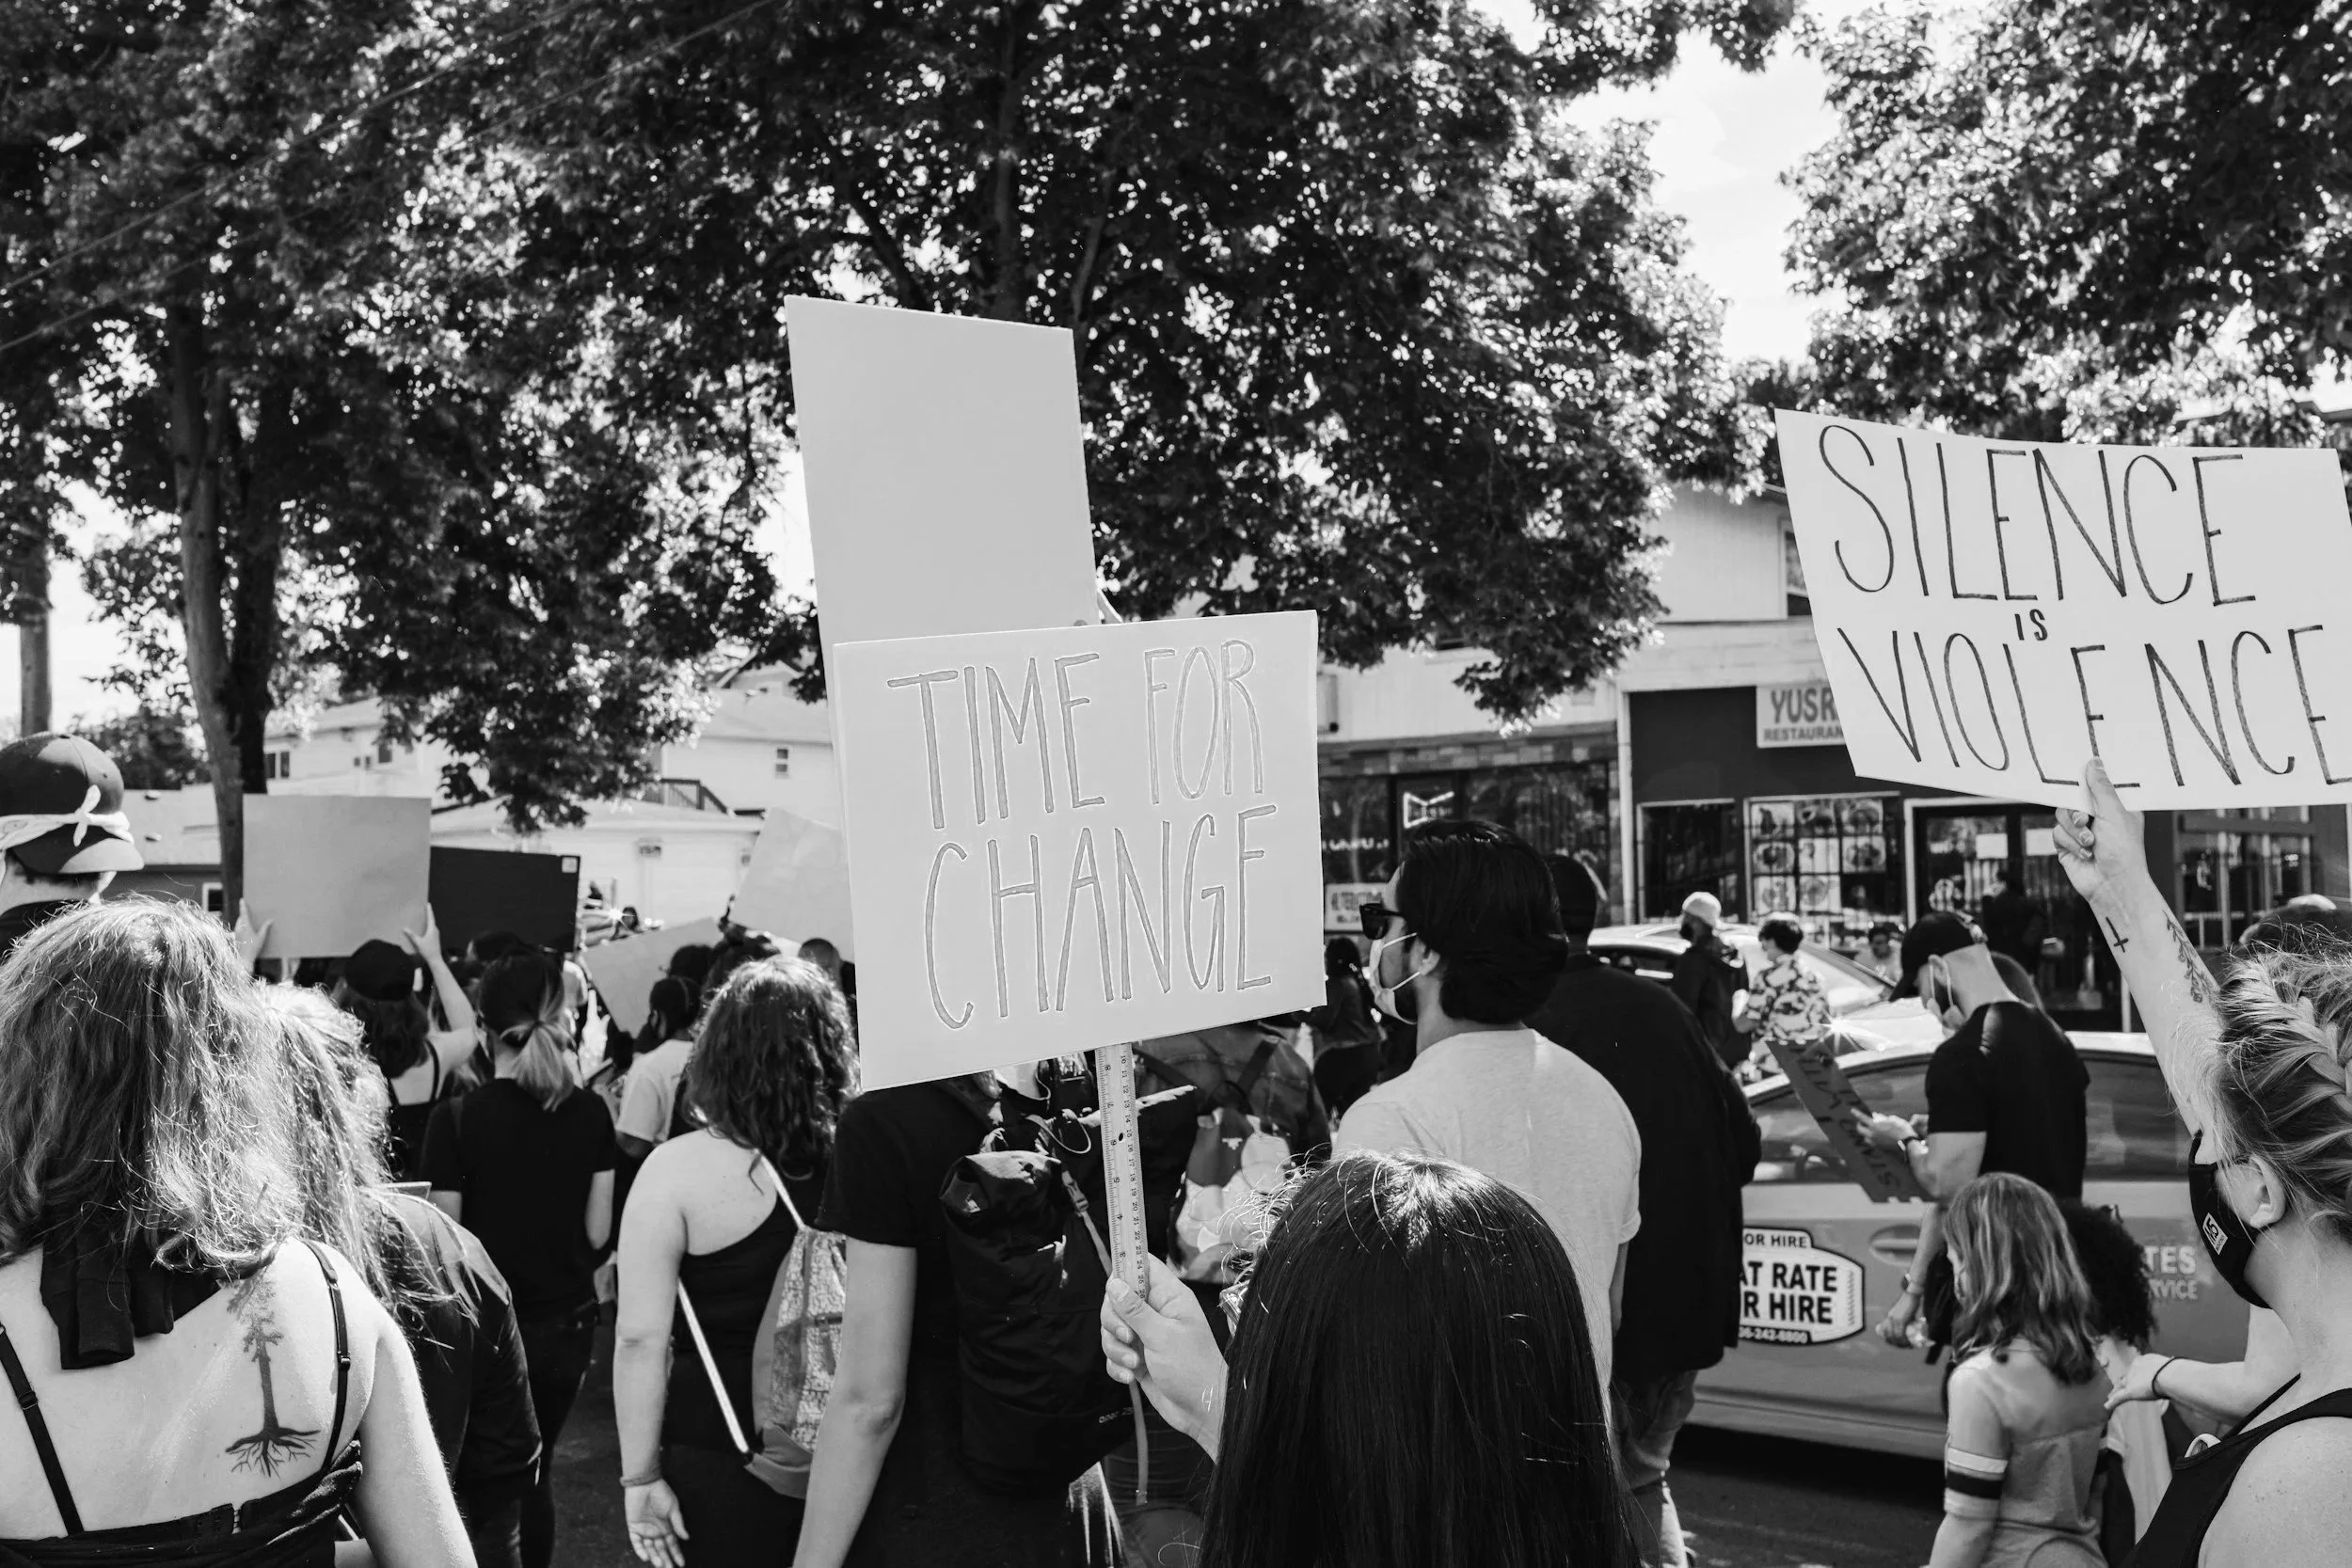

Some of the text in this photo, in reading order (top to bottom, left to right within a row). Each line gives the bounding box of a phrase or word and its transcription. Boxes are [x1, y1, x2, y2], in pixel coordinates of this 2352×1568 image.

[1819, 424, 2256, 607] SILENCE
[2013, 609, 2048, 641] IS
[1771, 687, 1837, 723] YUSR
[1836, 624, 2352, 788] VIOLENCE
[887, 640, 1263, 830] TIME FOR
[925, 805, 1277, 1029] CHANGE
[1771, 1234, 1807, 1248] HIRE
[1772, 1262, 1837, 1292] RATE
[1769, 1292, 1833, 1324] HIRE
